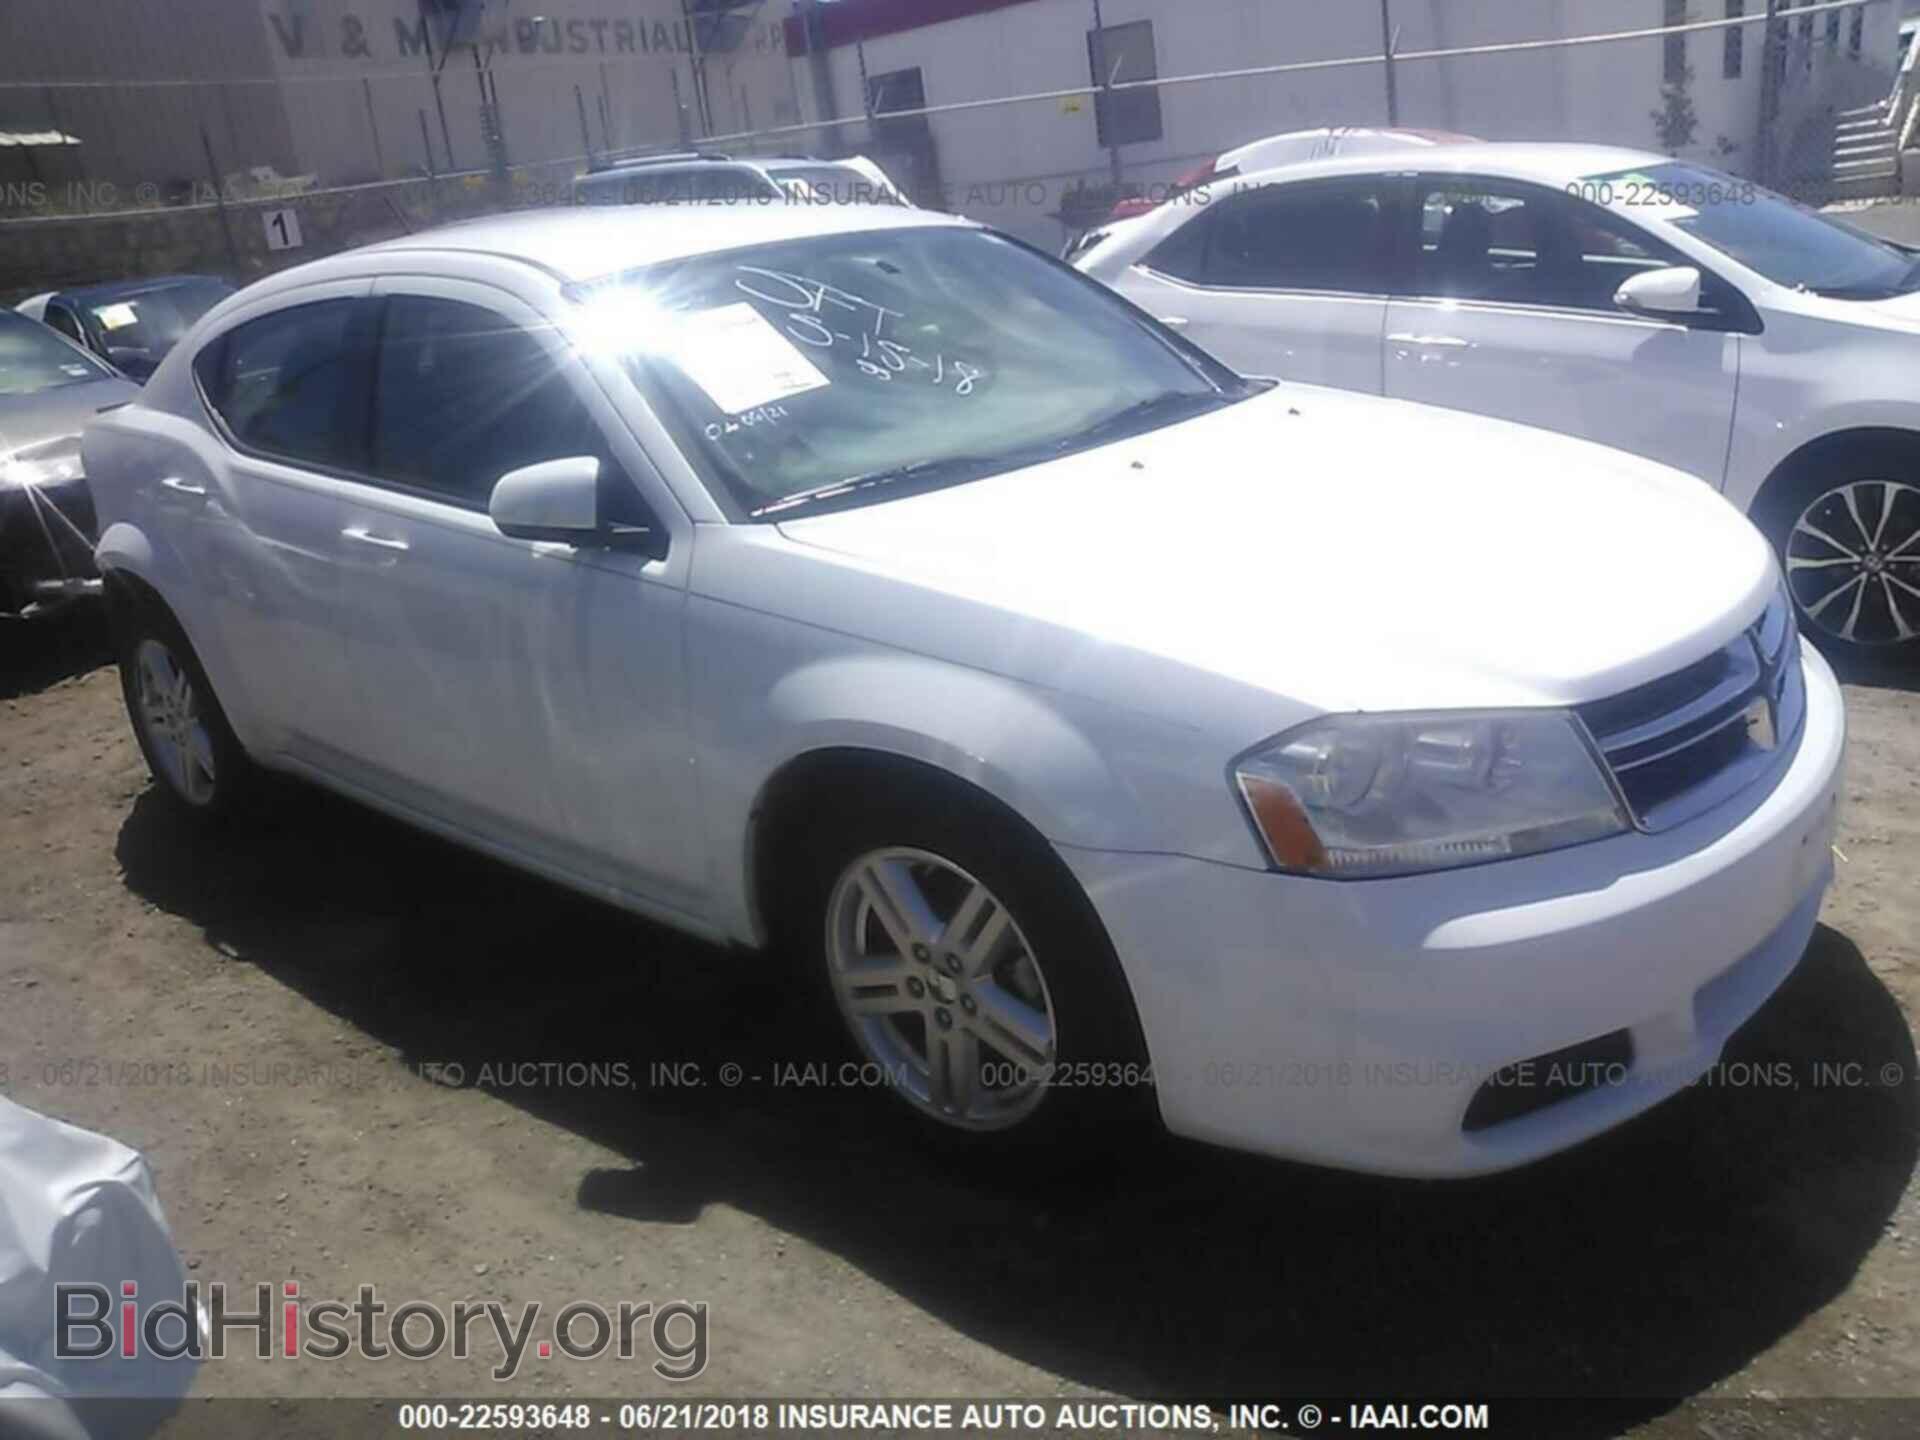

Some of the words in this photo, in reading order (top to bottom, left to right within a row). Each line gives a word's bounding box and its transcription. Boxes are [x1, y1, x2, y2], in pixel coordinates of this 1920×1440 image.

[268, 15, 304, 58] V
[340, 14, 374, 58] &
[393, 16, 430, 57] M
[466, 17, 698, 57] NDUSTRIAL
[272, 211, 290, 246] 1
